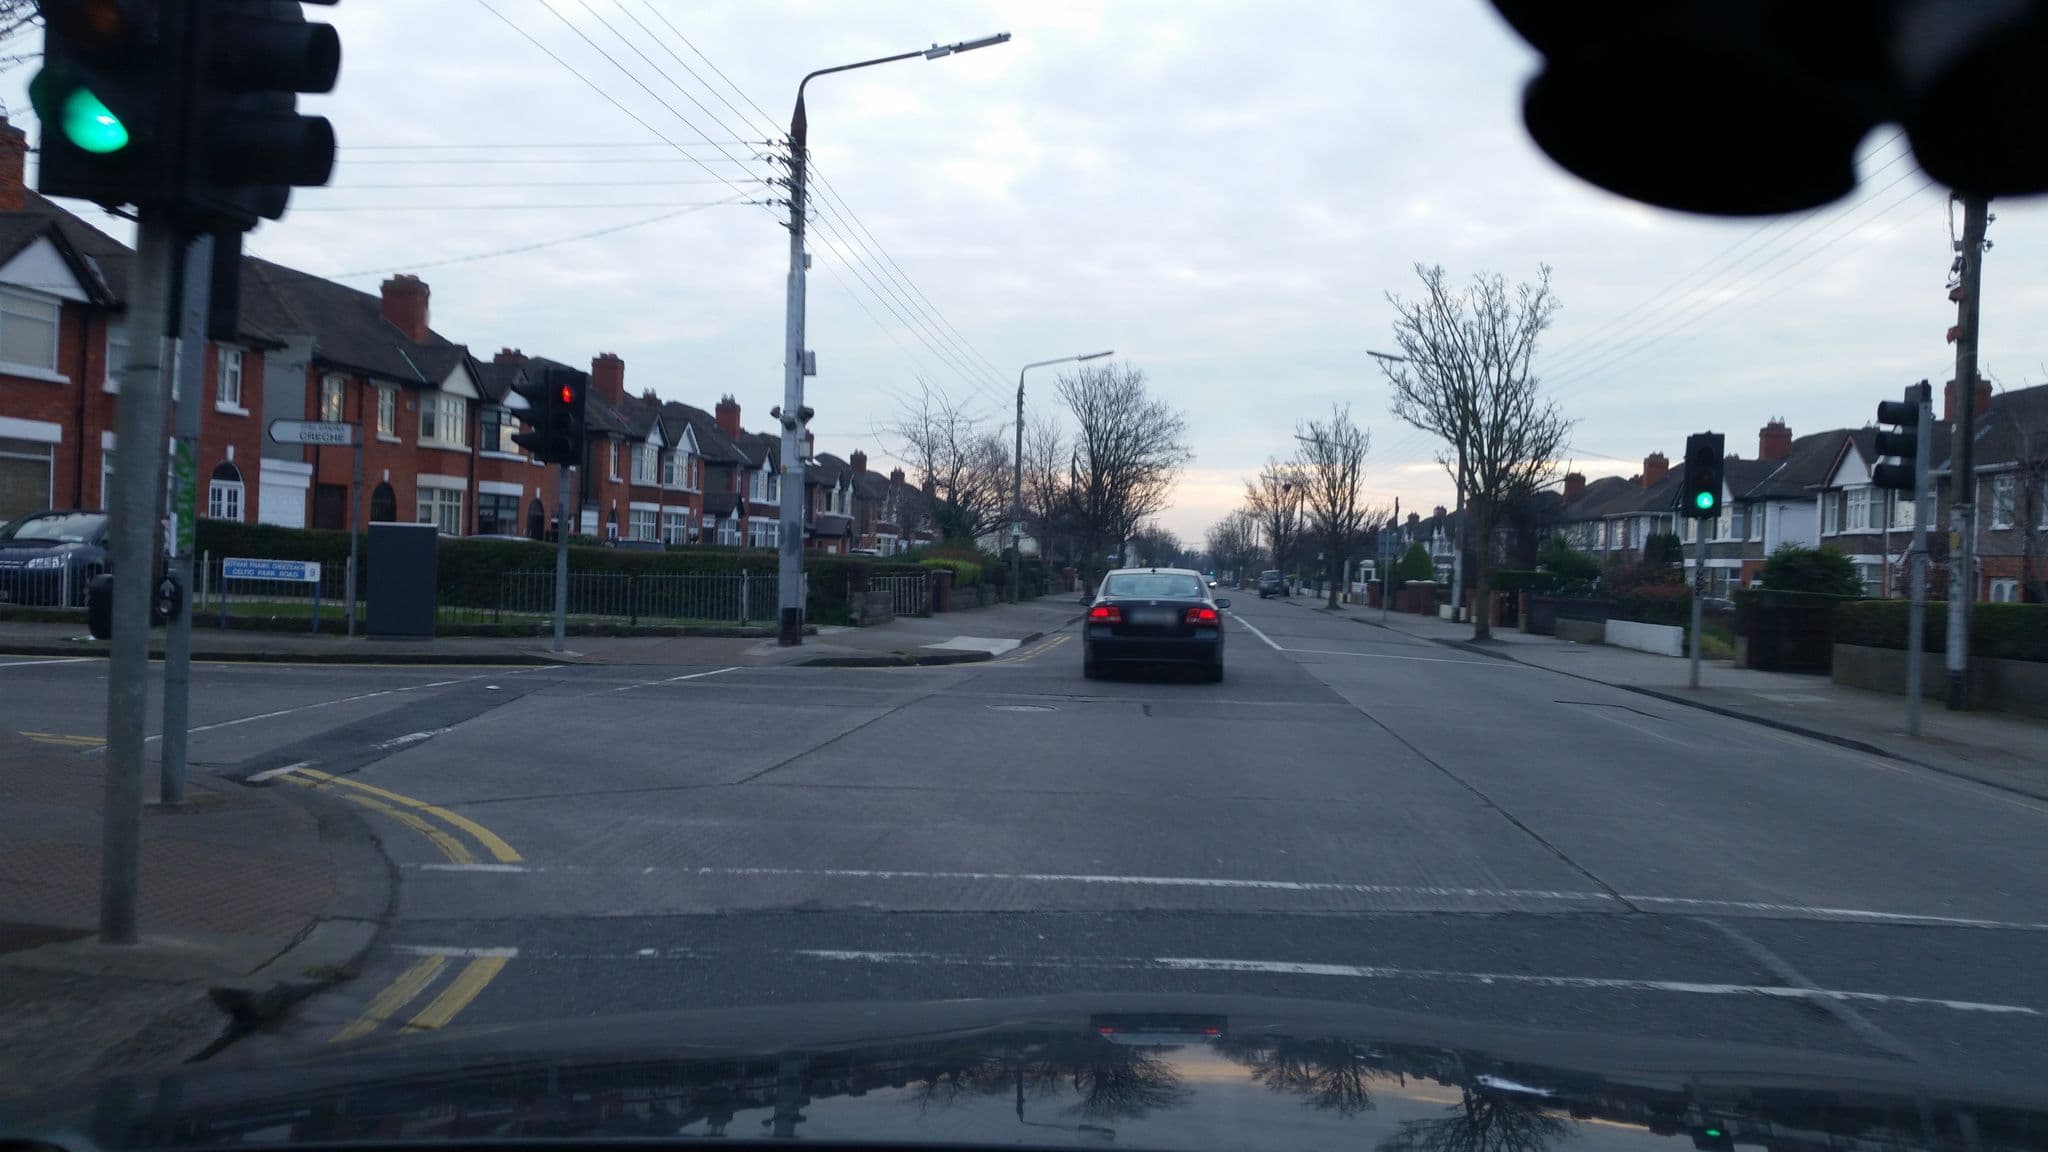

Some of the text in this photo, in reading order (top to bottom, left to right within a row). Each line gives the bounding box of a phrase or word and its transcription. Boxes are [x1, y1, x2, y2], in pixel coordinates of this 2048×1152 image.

[299, 431, 344, 441] CRECHE
[257, 569, 275, 577] PARK
[279, 570, 298, 578] ROAD
